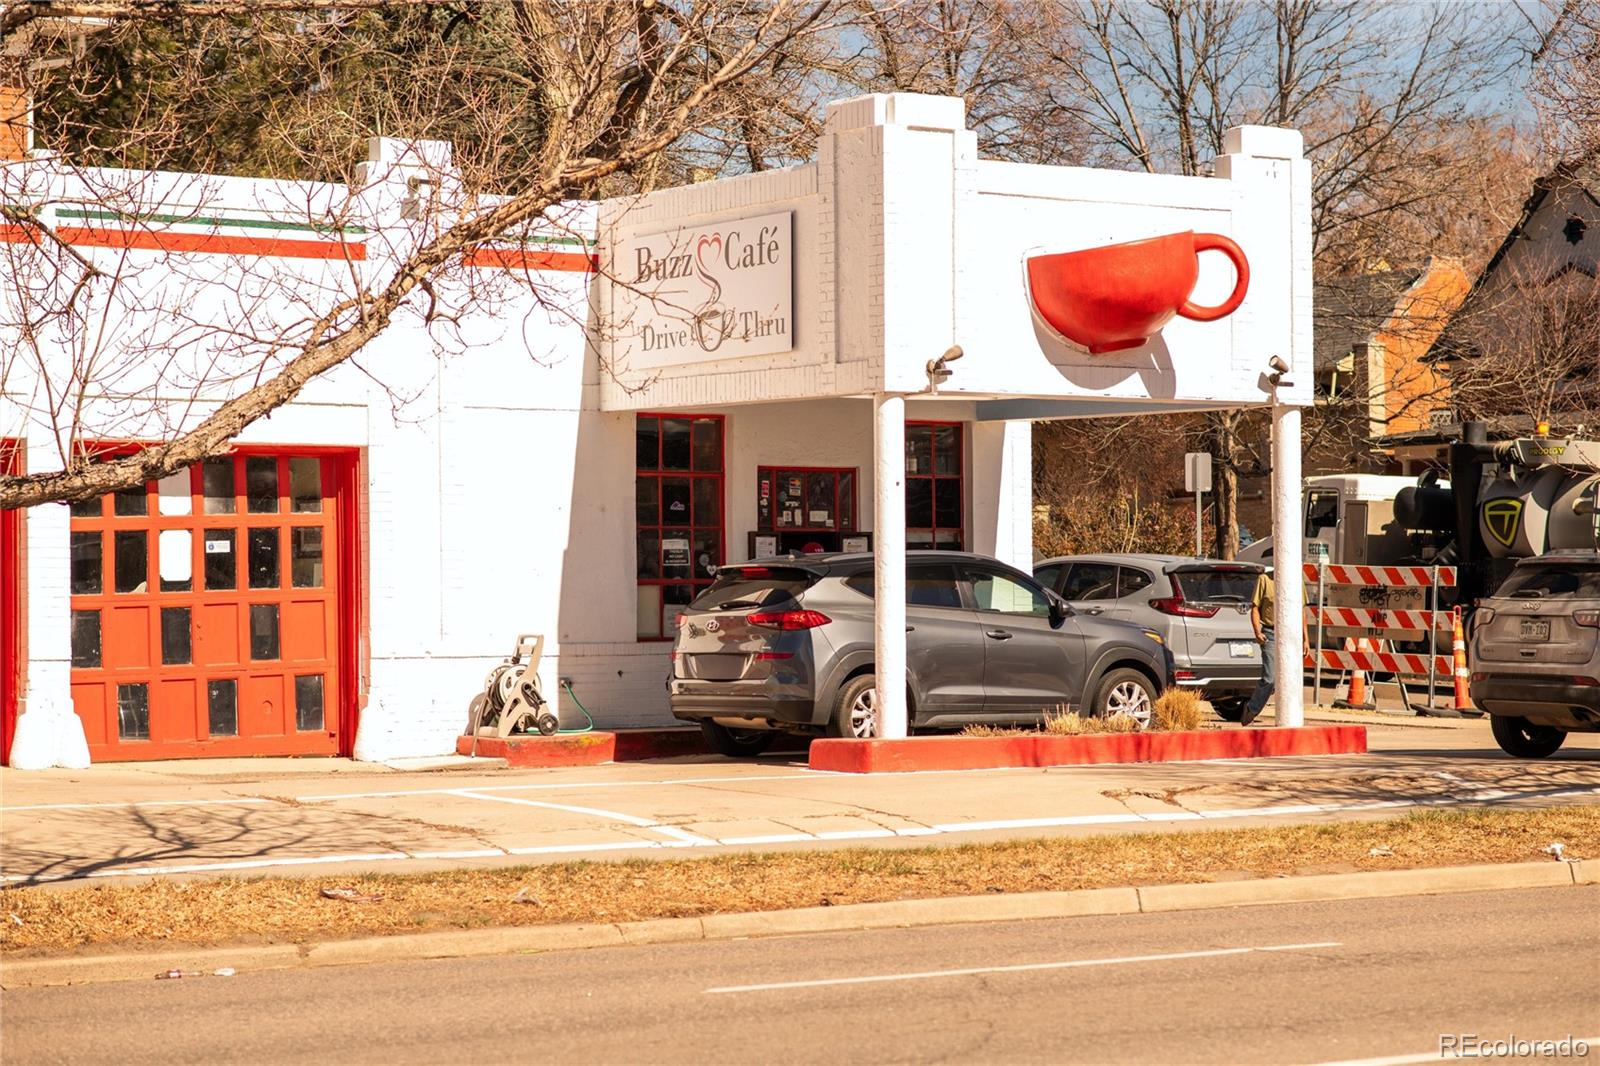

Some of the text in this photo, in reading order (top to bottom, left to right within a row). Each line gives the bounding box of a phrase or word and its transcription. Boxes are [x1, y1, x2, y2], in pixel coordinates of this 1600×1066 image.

[634, 226, 780, 283] Buzz Café
[641, 309, 786, 351] Drive Thru
[1530, 447, 1565, 455] PRODIGY
